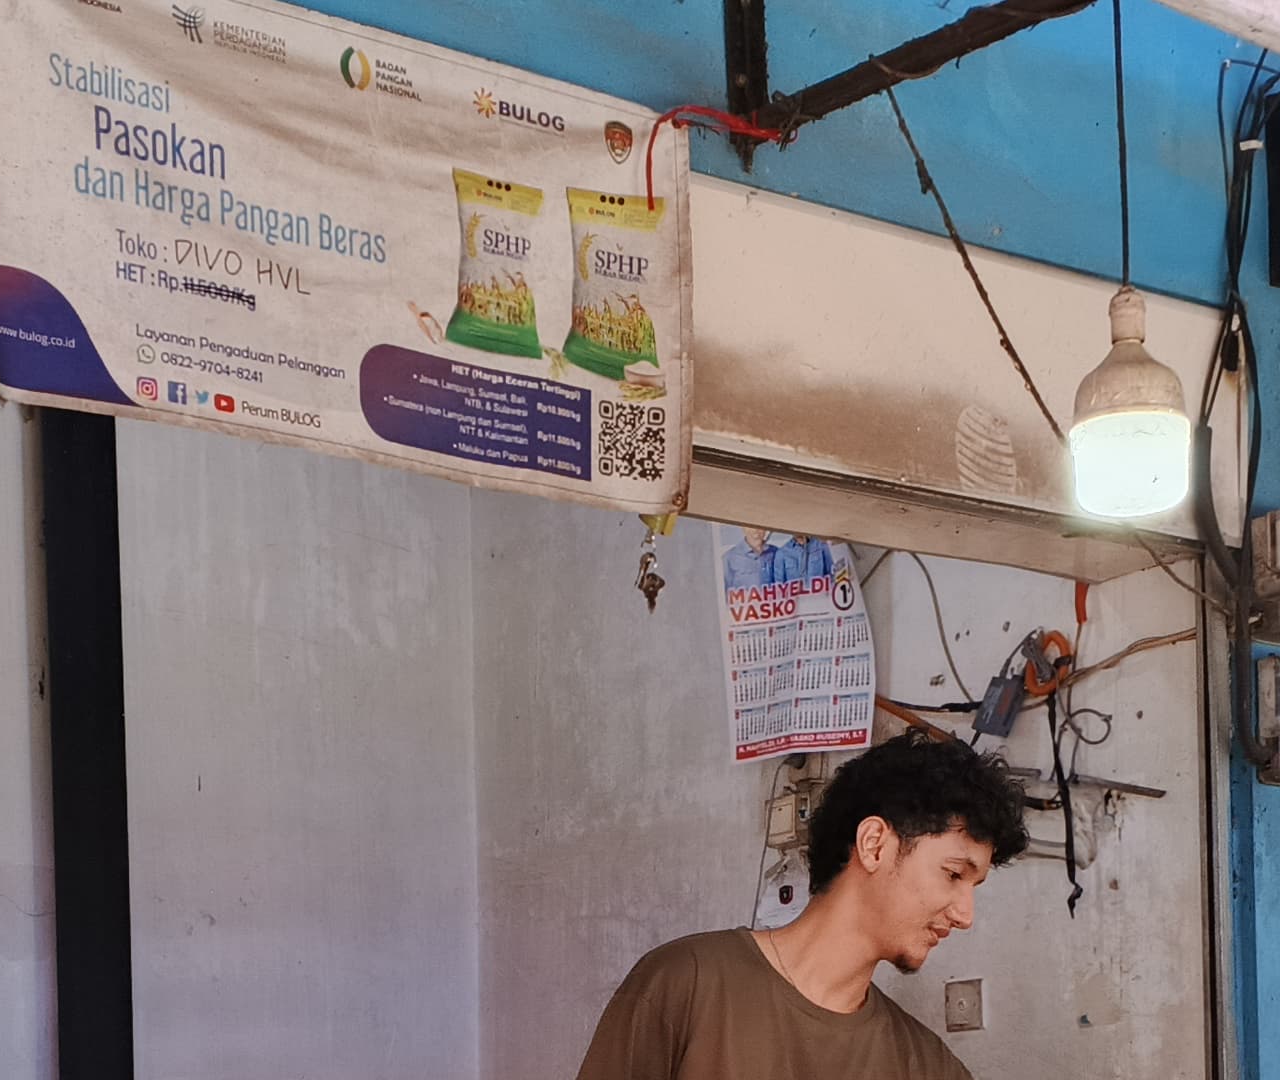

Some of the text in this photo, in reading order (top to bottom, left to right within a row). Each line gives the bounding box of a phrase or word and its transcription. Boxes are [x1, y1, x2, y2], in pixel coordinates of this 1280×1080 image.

[214, 21, 286, 47] KEMENTERIAN
[375, 59, 407, 75] BADAN
[375, 71, 413, 88] PANGAN
[49, 52, 169, 113] Stabilisasi
[375, 81, 422, 102] NASIONAL
[498, 100, 565, 132] BULOG
[94, 105, 226, 180] Pasokan
[74, 156, 387, 264] dan Harga Pangan Beras
[483, 229, 532, 255] SPHP
[115, 229, 158, 261] Toko
[174, 239, 243, 276] DIVO
[257, 257, 311, 296] HVL
[115, 262, 146, 285] HET
[594, 249, 649, 277] SPHP
[135, 323, 346, 380] Layanan Pengaduan Pelanggan
[160, 351, 264, 384] 0822-9704-8241
[451, 364, 470, 376] HET
[241, 401, 321, 428] Perum BULOG
[728, 577, 831, 605] MAHYELDI
[730, 599, 797, 622] VASKO
